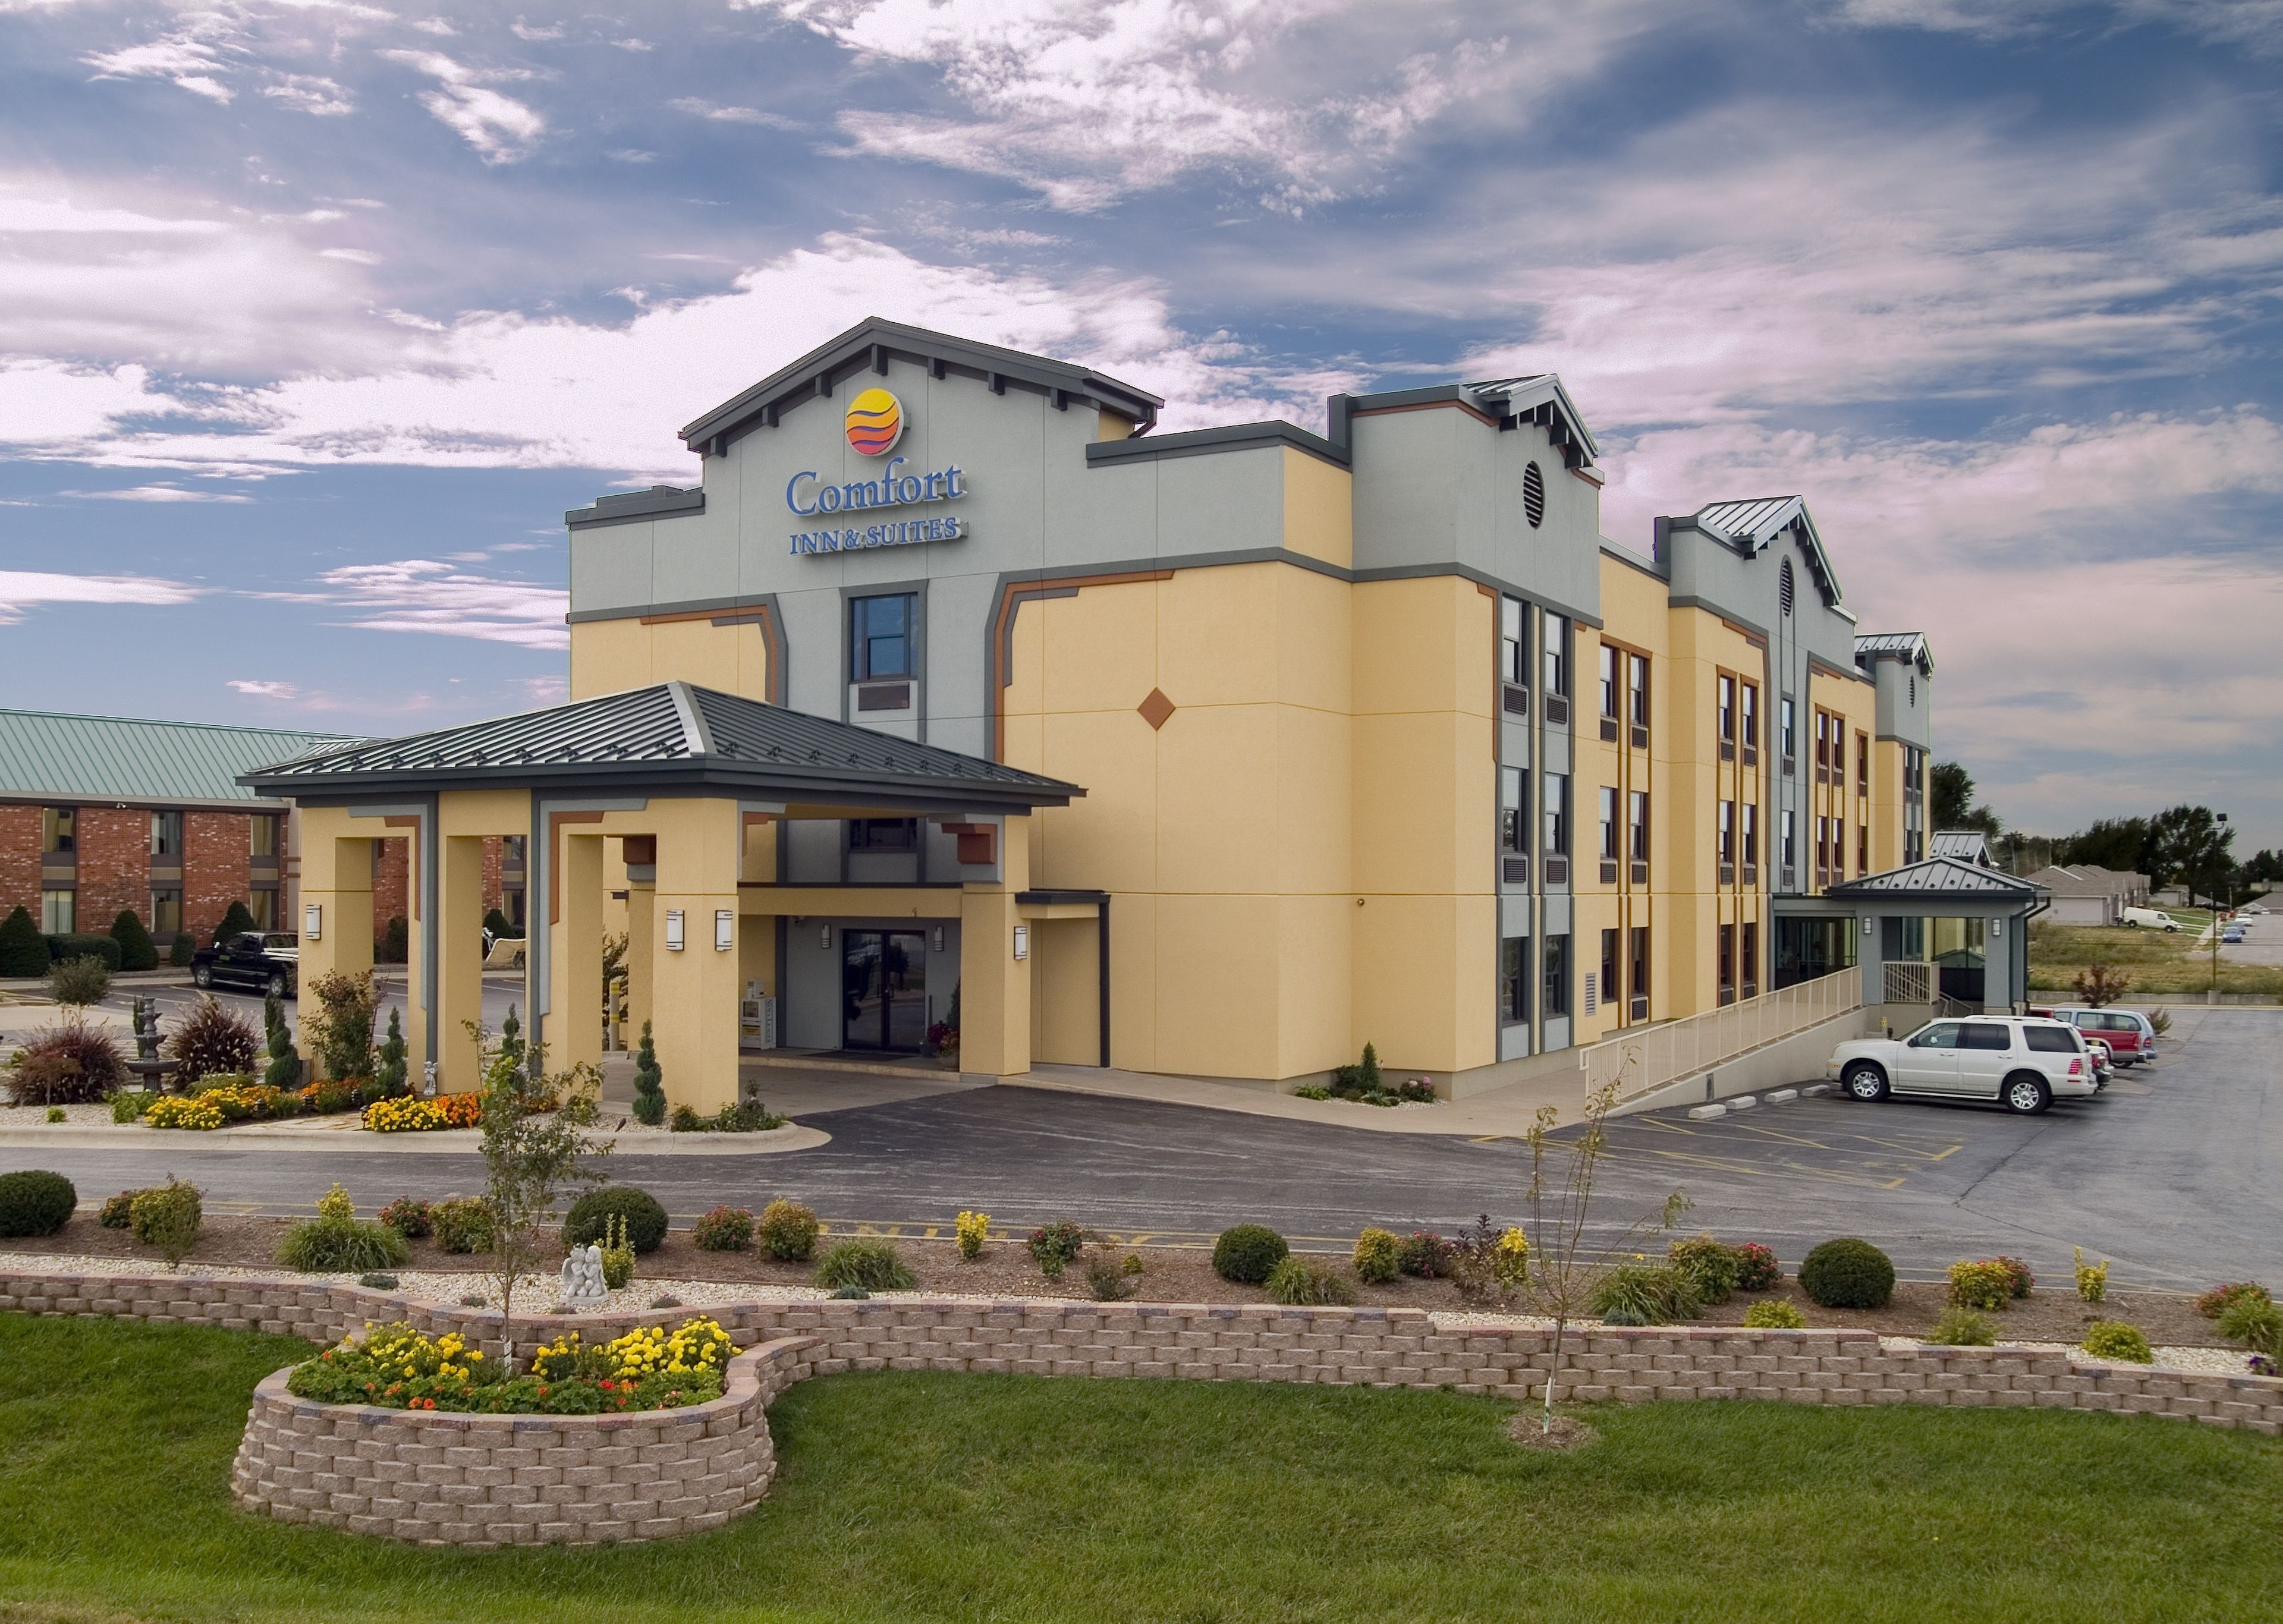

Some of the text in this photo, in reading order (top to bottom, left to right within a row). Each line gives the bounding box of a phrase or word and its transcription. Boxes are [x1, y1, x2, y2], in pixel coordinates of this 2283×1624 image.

[787, 457, 967, 515] Comfort
[790, 517, 960, 555] INN & SUITES
